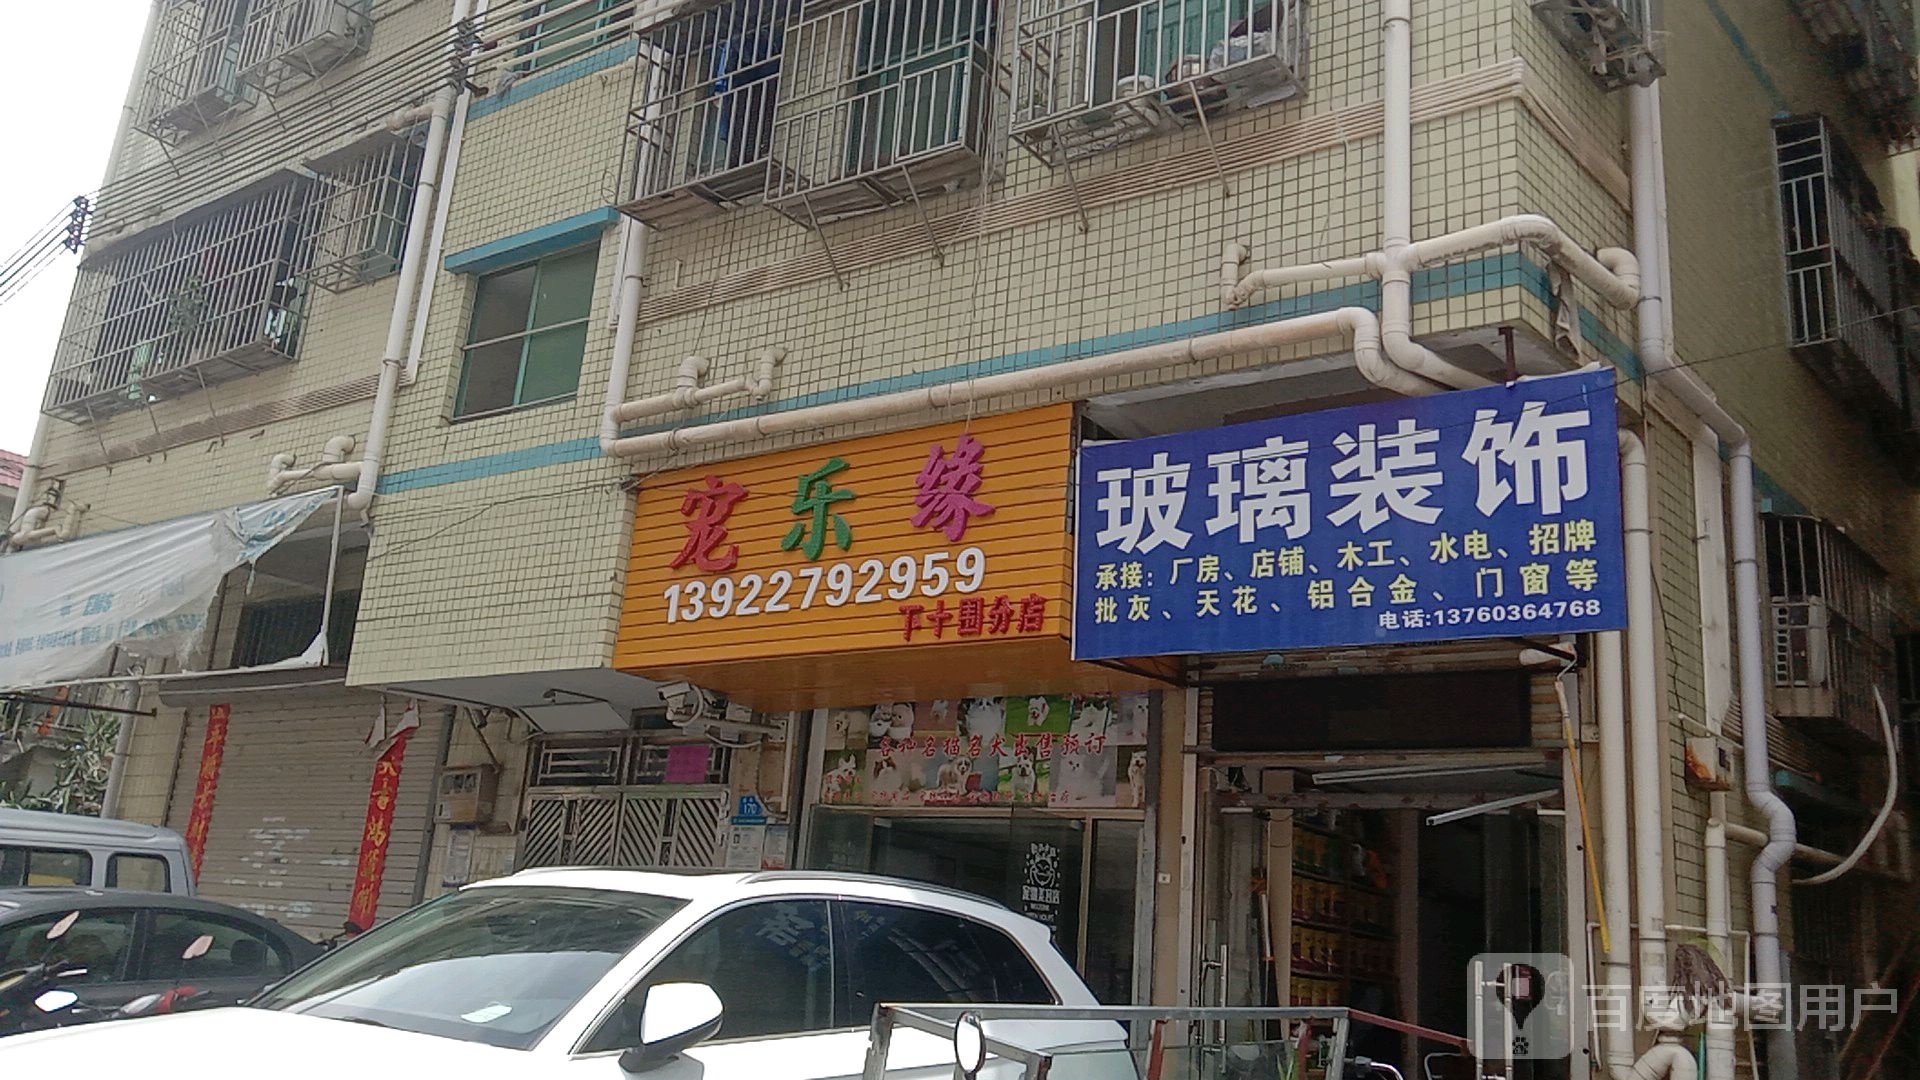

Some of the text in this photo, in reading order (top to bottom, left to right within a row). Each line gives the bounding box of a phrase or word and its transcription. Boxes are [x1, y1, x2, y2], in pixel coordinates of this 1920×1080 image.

[669, 433, 996, 573] 宠乐缘
[1096, 401, 1591, 555] 玻璃装饰
[663, 547, 986, 624] 13922792959
[899, 593, 1048, 642] 下十围分店
[1095, 558, 1599, 624] 批灰、天花、铝合金、门窗等
[1379, 599, 1601, 630] 电话:13760364768
[879, 732, 1108, 760] 各种名猫名犬出售预订
